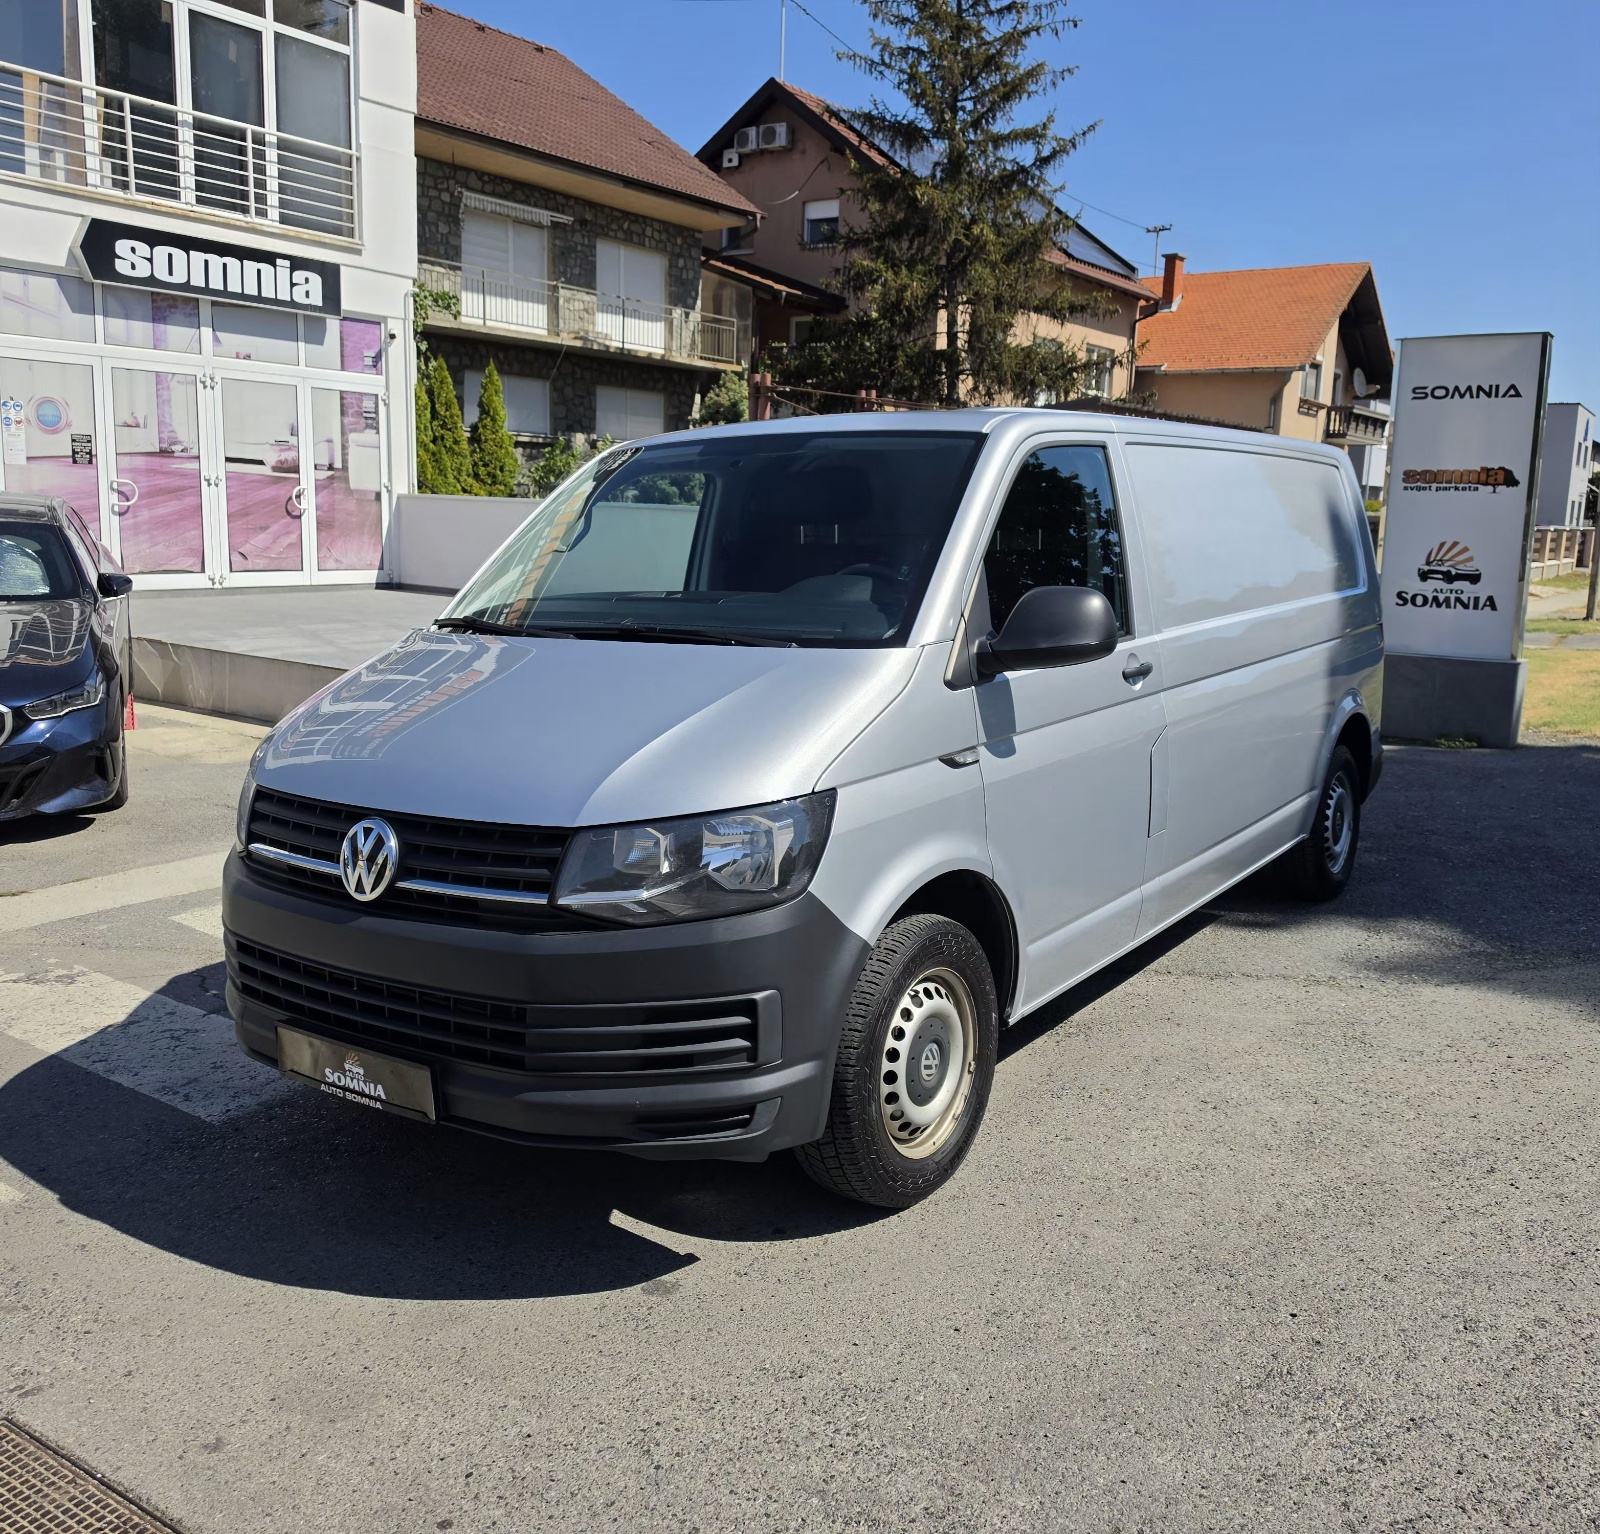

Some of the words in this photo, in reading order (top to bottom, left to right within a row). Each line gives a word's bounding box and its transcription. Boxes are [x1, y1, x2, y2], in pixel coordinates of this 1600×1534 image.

[115, 239, 323, 307] somnia
[1410, 383, 1523, 401] SOMNIA
[1401, 466, 1505, 486] somnia
[1395, 590, 1498, 612] SOMNIA
[324, 1067, 386, 1100] SOMNIA
[345, 1070, 364, 1081] AUTO
[320, 1083, 344, 1097] AUTO
[345, 1091, 383, 1110] SOMNIA
